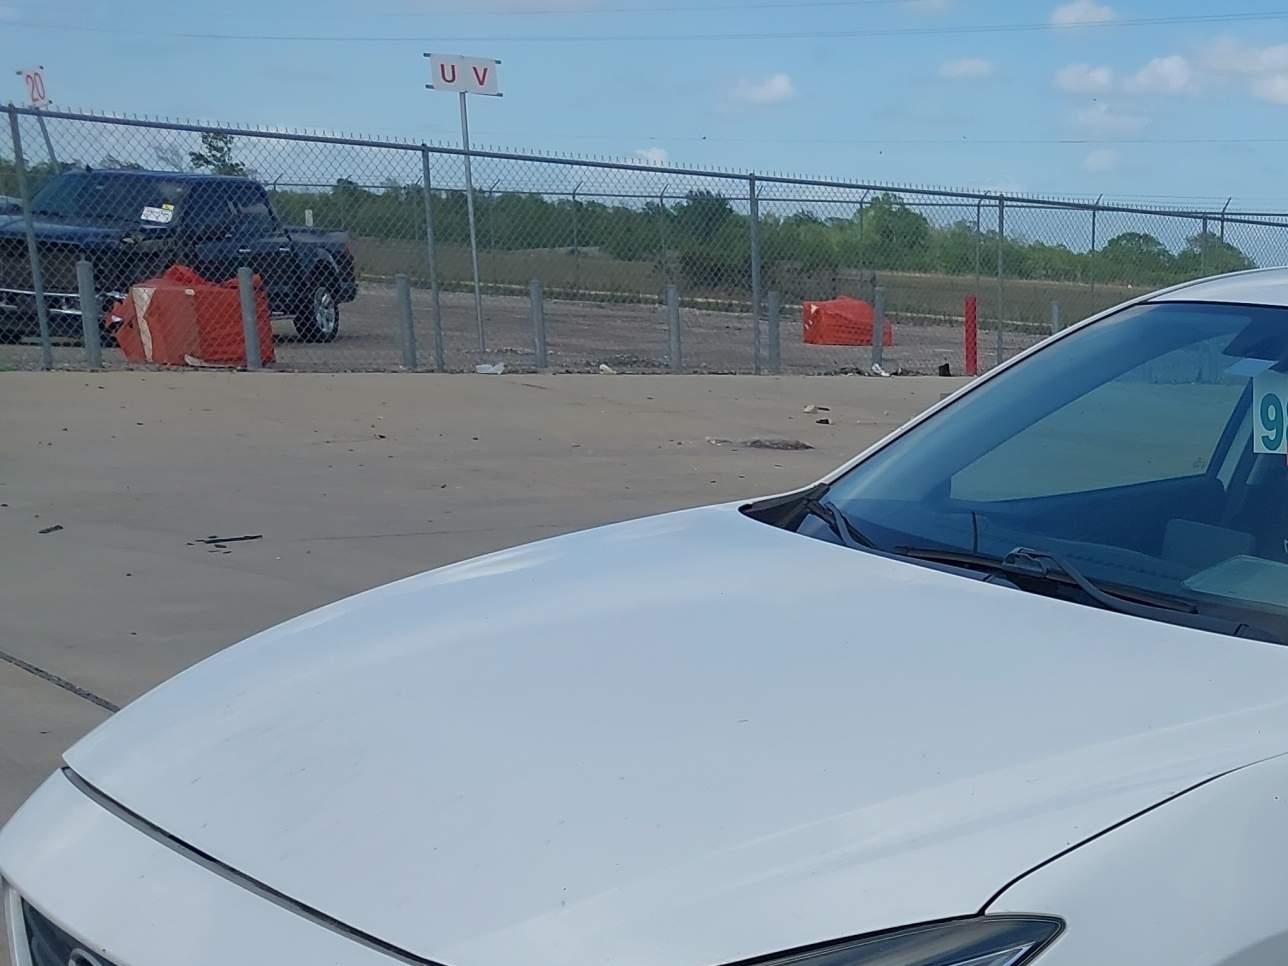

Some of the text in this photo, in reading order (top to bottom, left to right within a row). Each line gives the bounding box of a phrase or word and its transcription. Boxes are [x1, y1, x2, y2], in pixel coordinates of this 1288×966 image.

[26, 72, 46, 102] 20
[440, 63, 488, 86] U V
